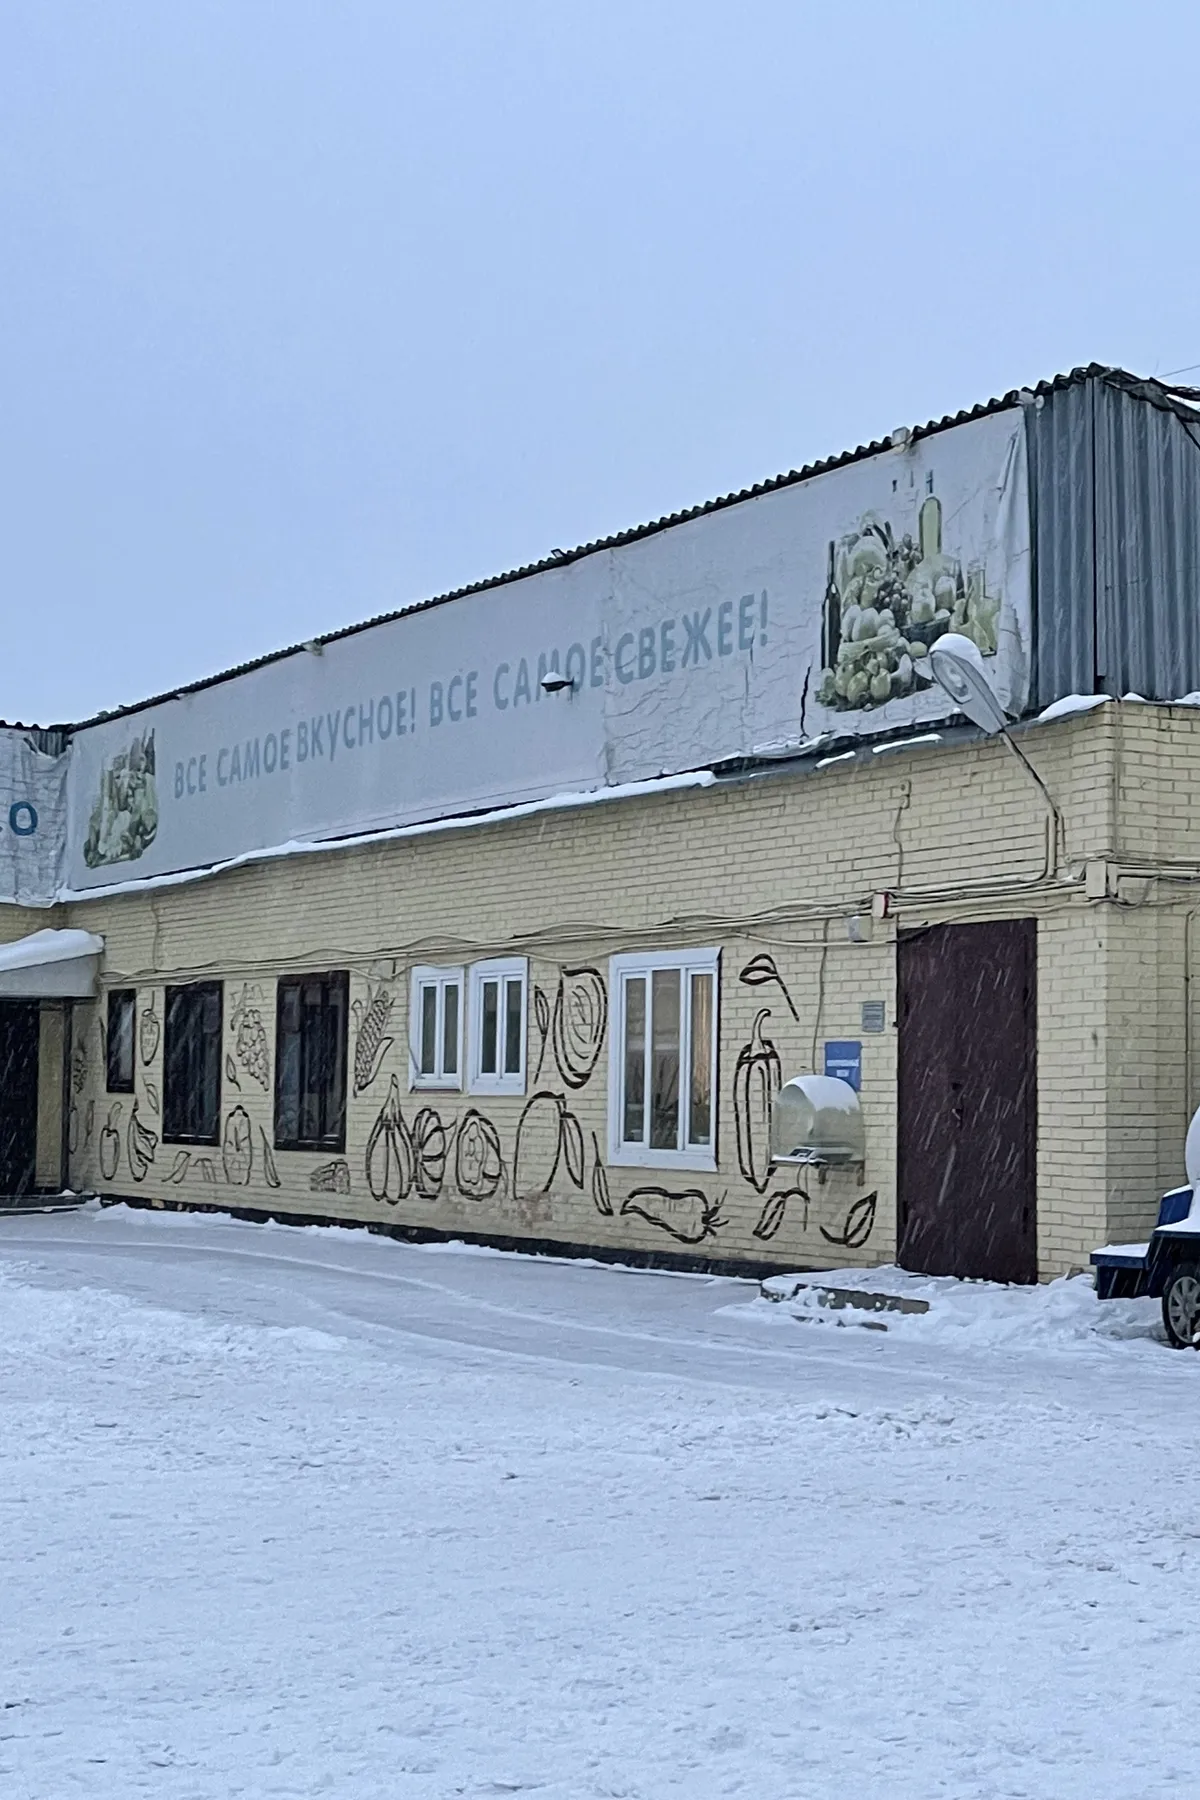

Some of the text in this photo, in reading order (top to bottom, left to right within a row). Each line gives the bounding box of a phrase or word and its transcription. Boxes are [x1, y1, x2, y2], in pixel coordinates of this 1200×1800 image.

[174, 588, 769, 799] ВСЕ САМОЕ ВКУСНОЕ! ВСЕ САМОЕ СВЕЖЕЕ!
